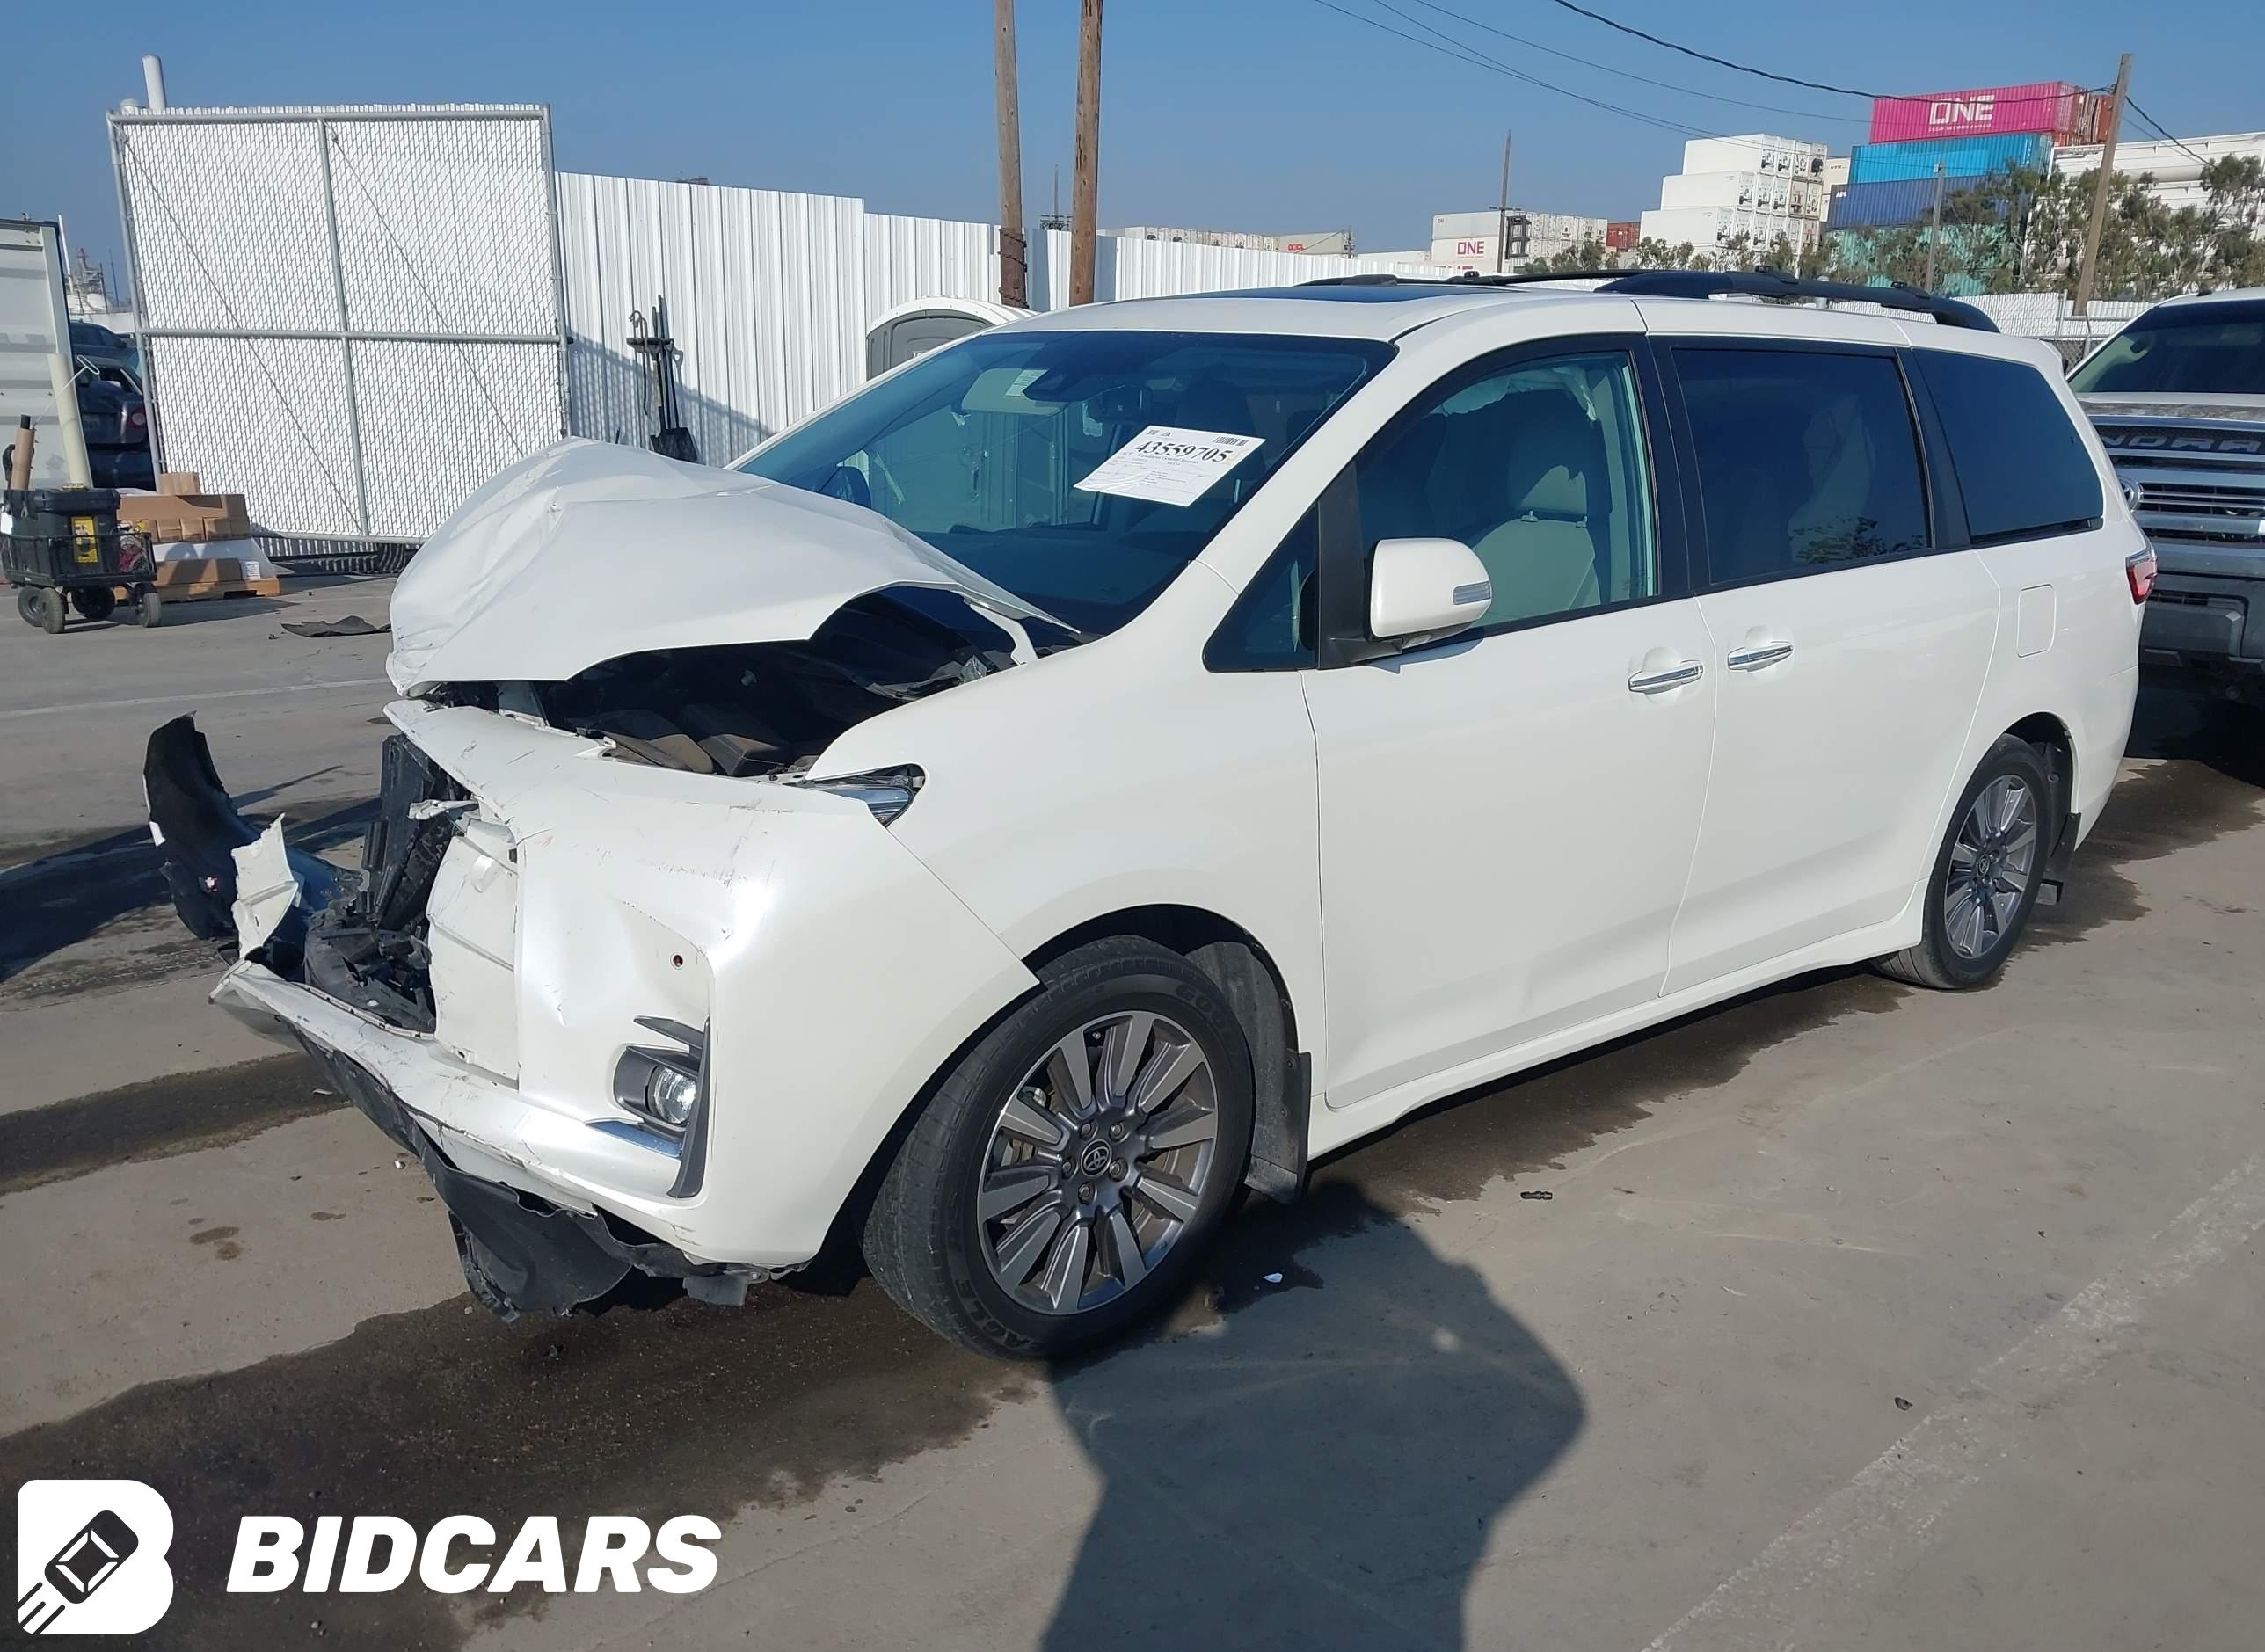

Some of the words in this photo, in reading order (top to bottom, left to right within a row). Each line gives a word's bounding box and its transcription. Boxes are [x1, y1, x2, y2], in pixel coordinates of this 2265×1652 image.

[1929, 95, 1994, 124] ONE
[1457, 241, 1484, 255] ONE
[1135, 440, 1234, 462] 43559705
